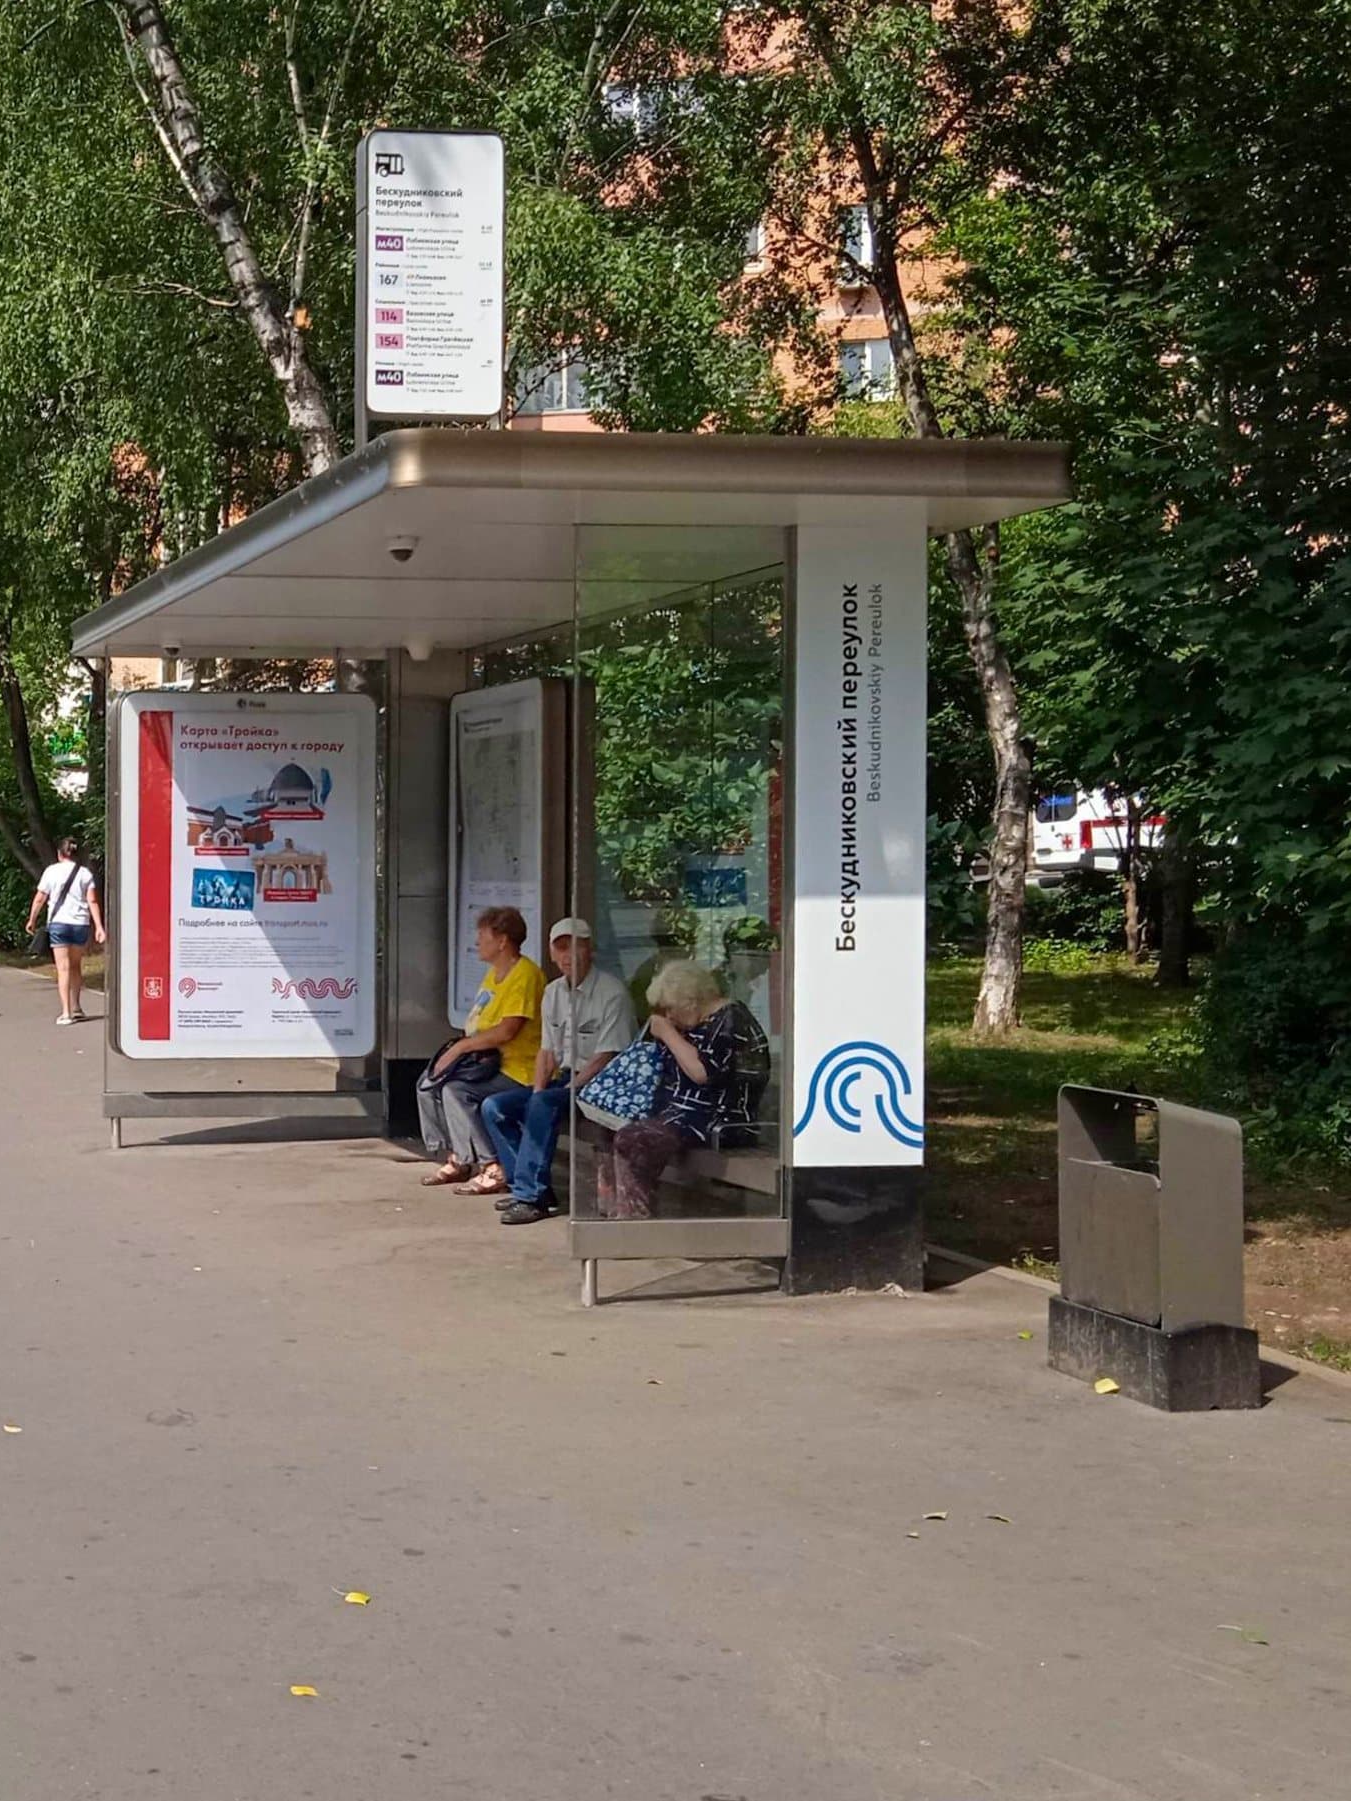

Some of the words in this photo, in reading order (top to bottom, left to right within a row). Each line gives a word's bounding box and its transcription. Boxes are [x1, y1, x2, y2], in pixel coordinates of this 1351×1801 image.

[375, 186, 463, 198] Бескудниковский
[375, 199, 422, 208] переулок
[379, 274, 399, 286] 167
[381, 311, 397, 321] 114
[379, 336, 399, 347] 154
[867, 583, 882, 657] Pereulok
[842, 583, 863, 710] переулок
[180, 725, 218, 738] Карта
[222, 725, 279, 738] «Тройка»
[866, 663, 884, 802] Beskudnikovskiy
[180, 741, 243, 752] открывает
[246, 741, 288, 753] доступ
[291, 742, 298, 750] к
[300, 742, 345, 753] городу
[836, 718, 861, 951] Бескудниковский
[178, 918, 226, 928] Подробнее
[239, 918, 262, 927] сайте
